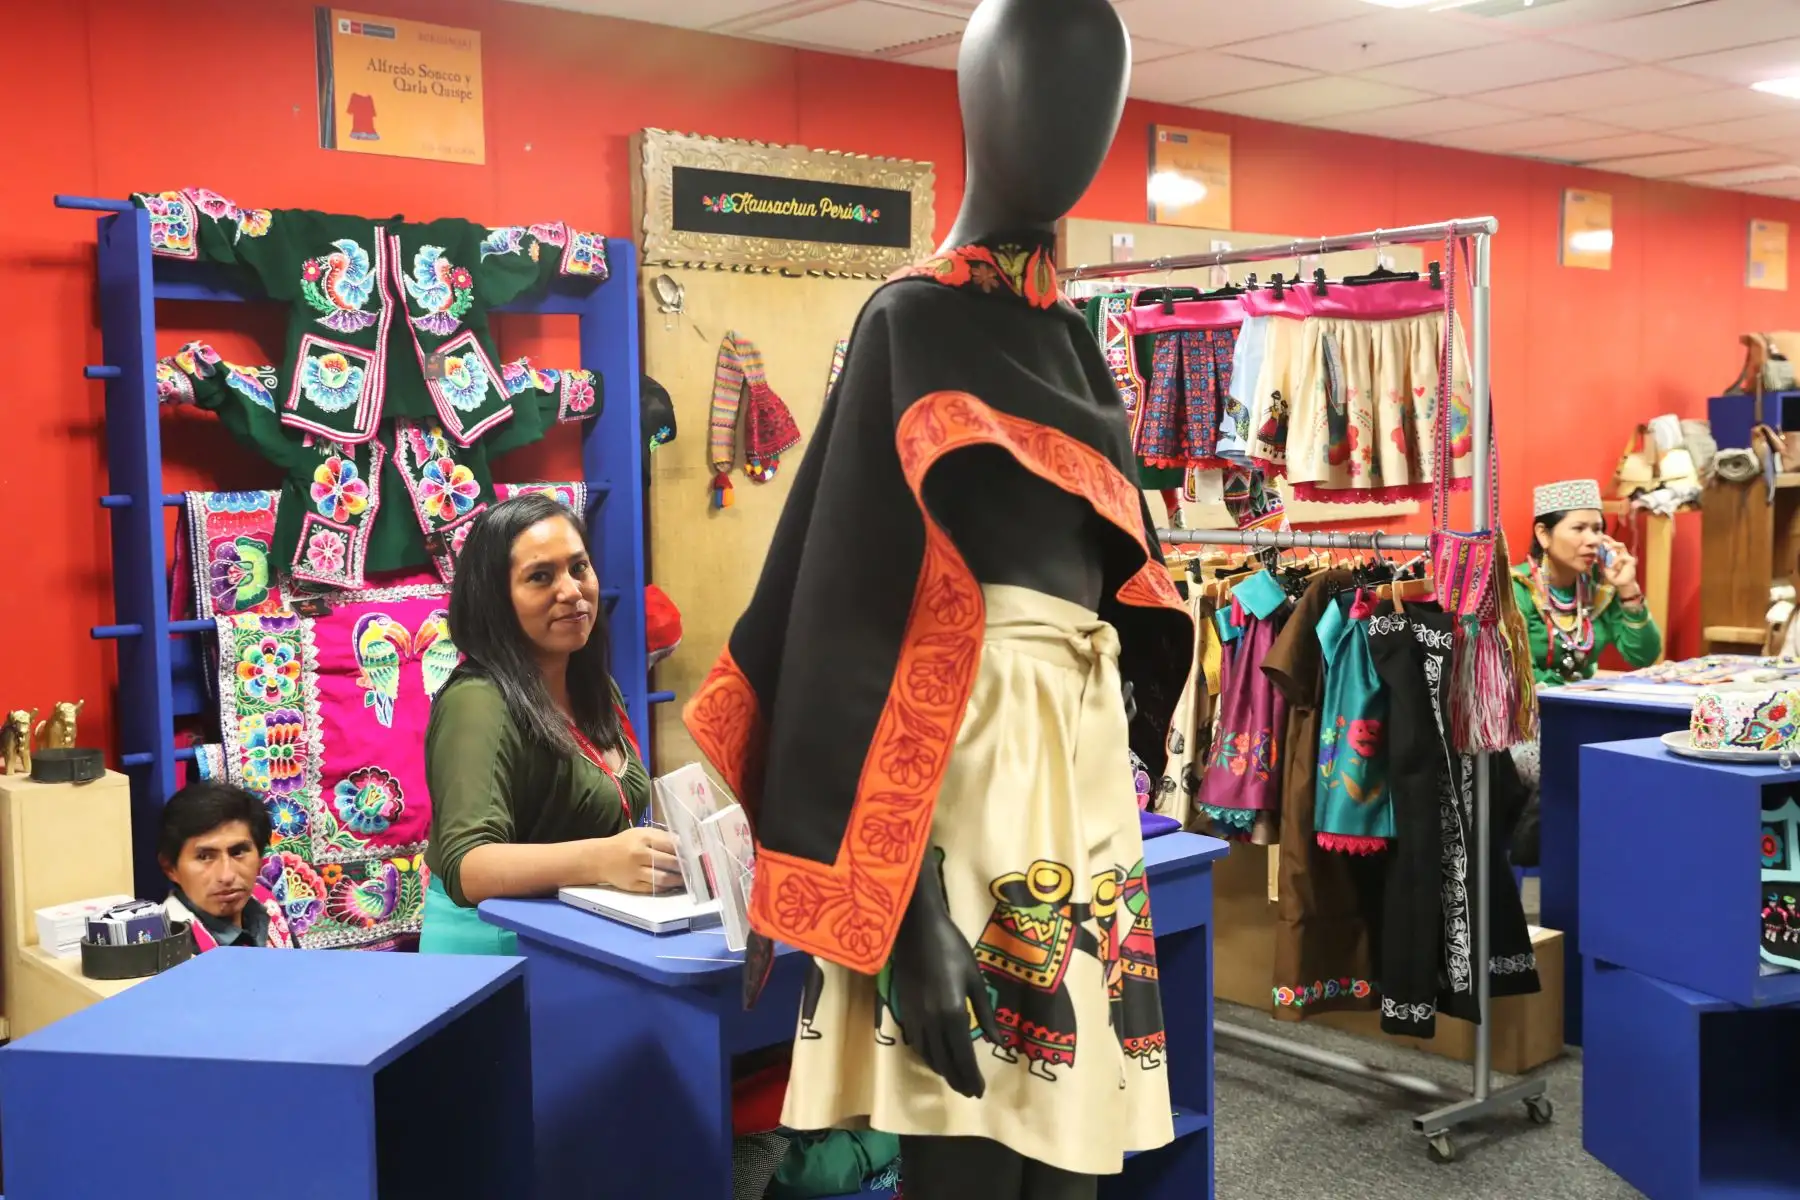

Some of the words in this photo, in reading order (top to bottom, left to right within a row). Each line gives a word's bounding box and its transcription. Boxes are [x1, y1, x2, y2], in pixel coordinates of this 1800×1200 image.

[366, 57, 415, 76] Alfredo
[464, 74, 472, 89] y
[431, 81, 473, 104] Quispe
[731, 191, 818, 217] Kausachun
[819, 197, 853, 220] Perú
